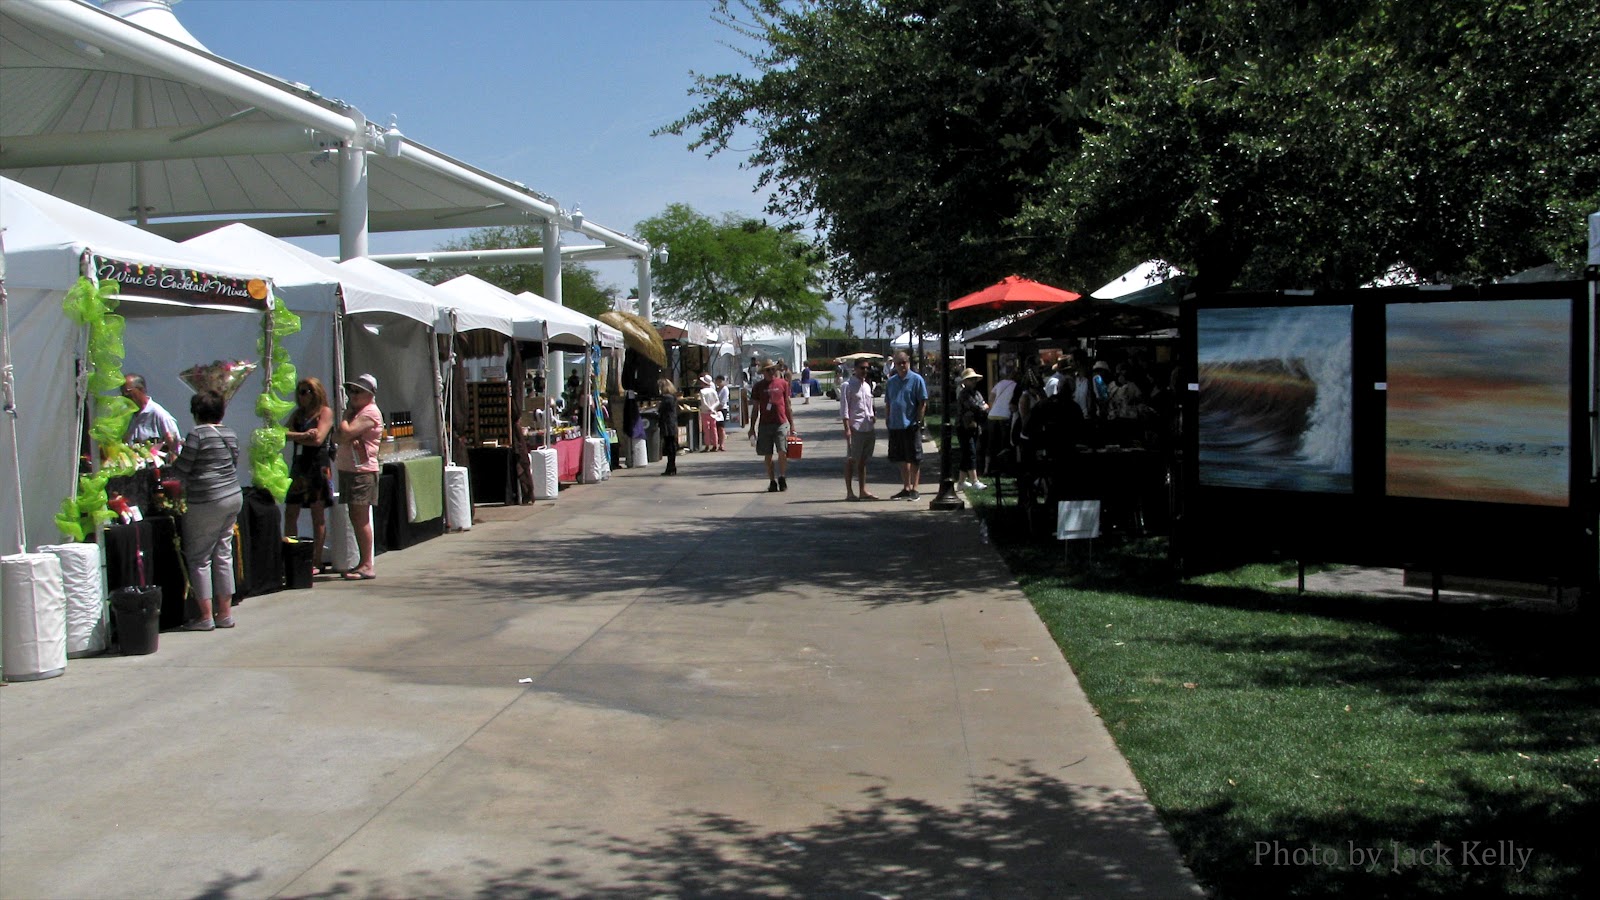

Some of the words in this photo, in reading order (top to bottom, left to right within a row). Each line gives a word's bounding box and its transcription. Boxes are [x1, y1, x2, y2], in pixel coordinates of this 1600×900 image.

[99, 264, 143, 285] Wine
[144, 274, 157, 287] &
[160, 275, 210, 293] Cocktail
